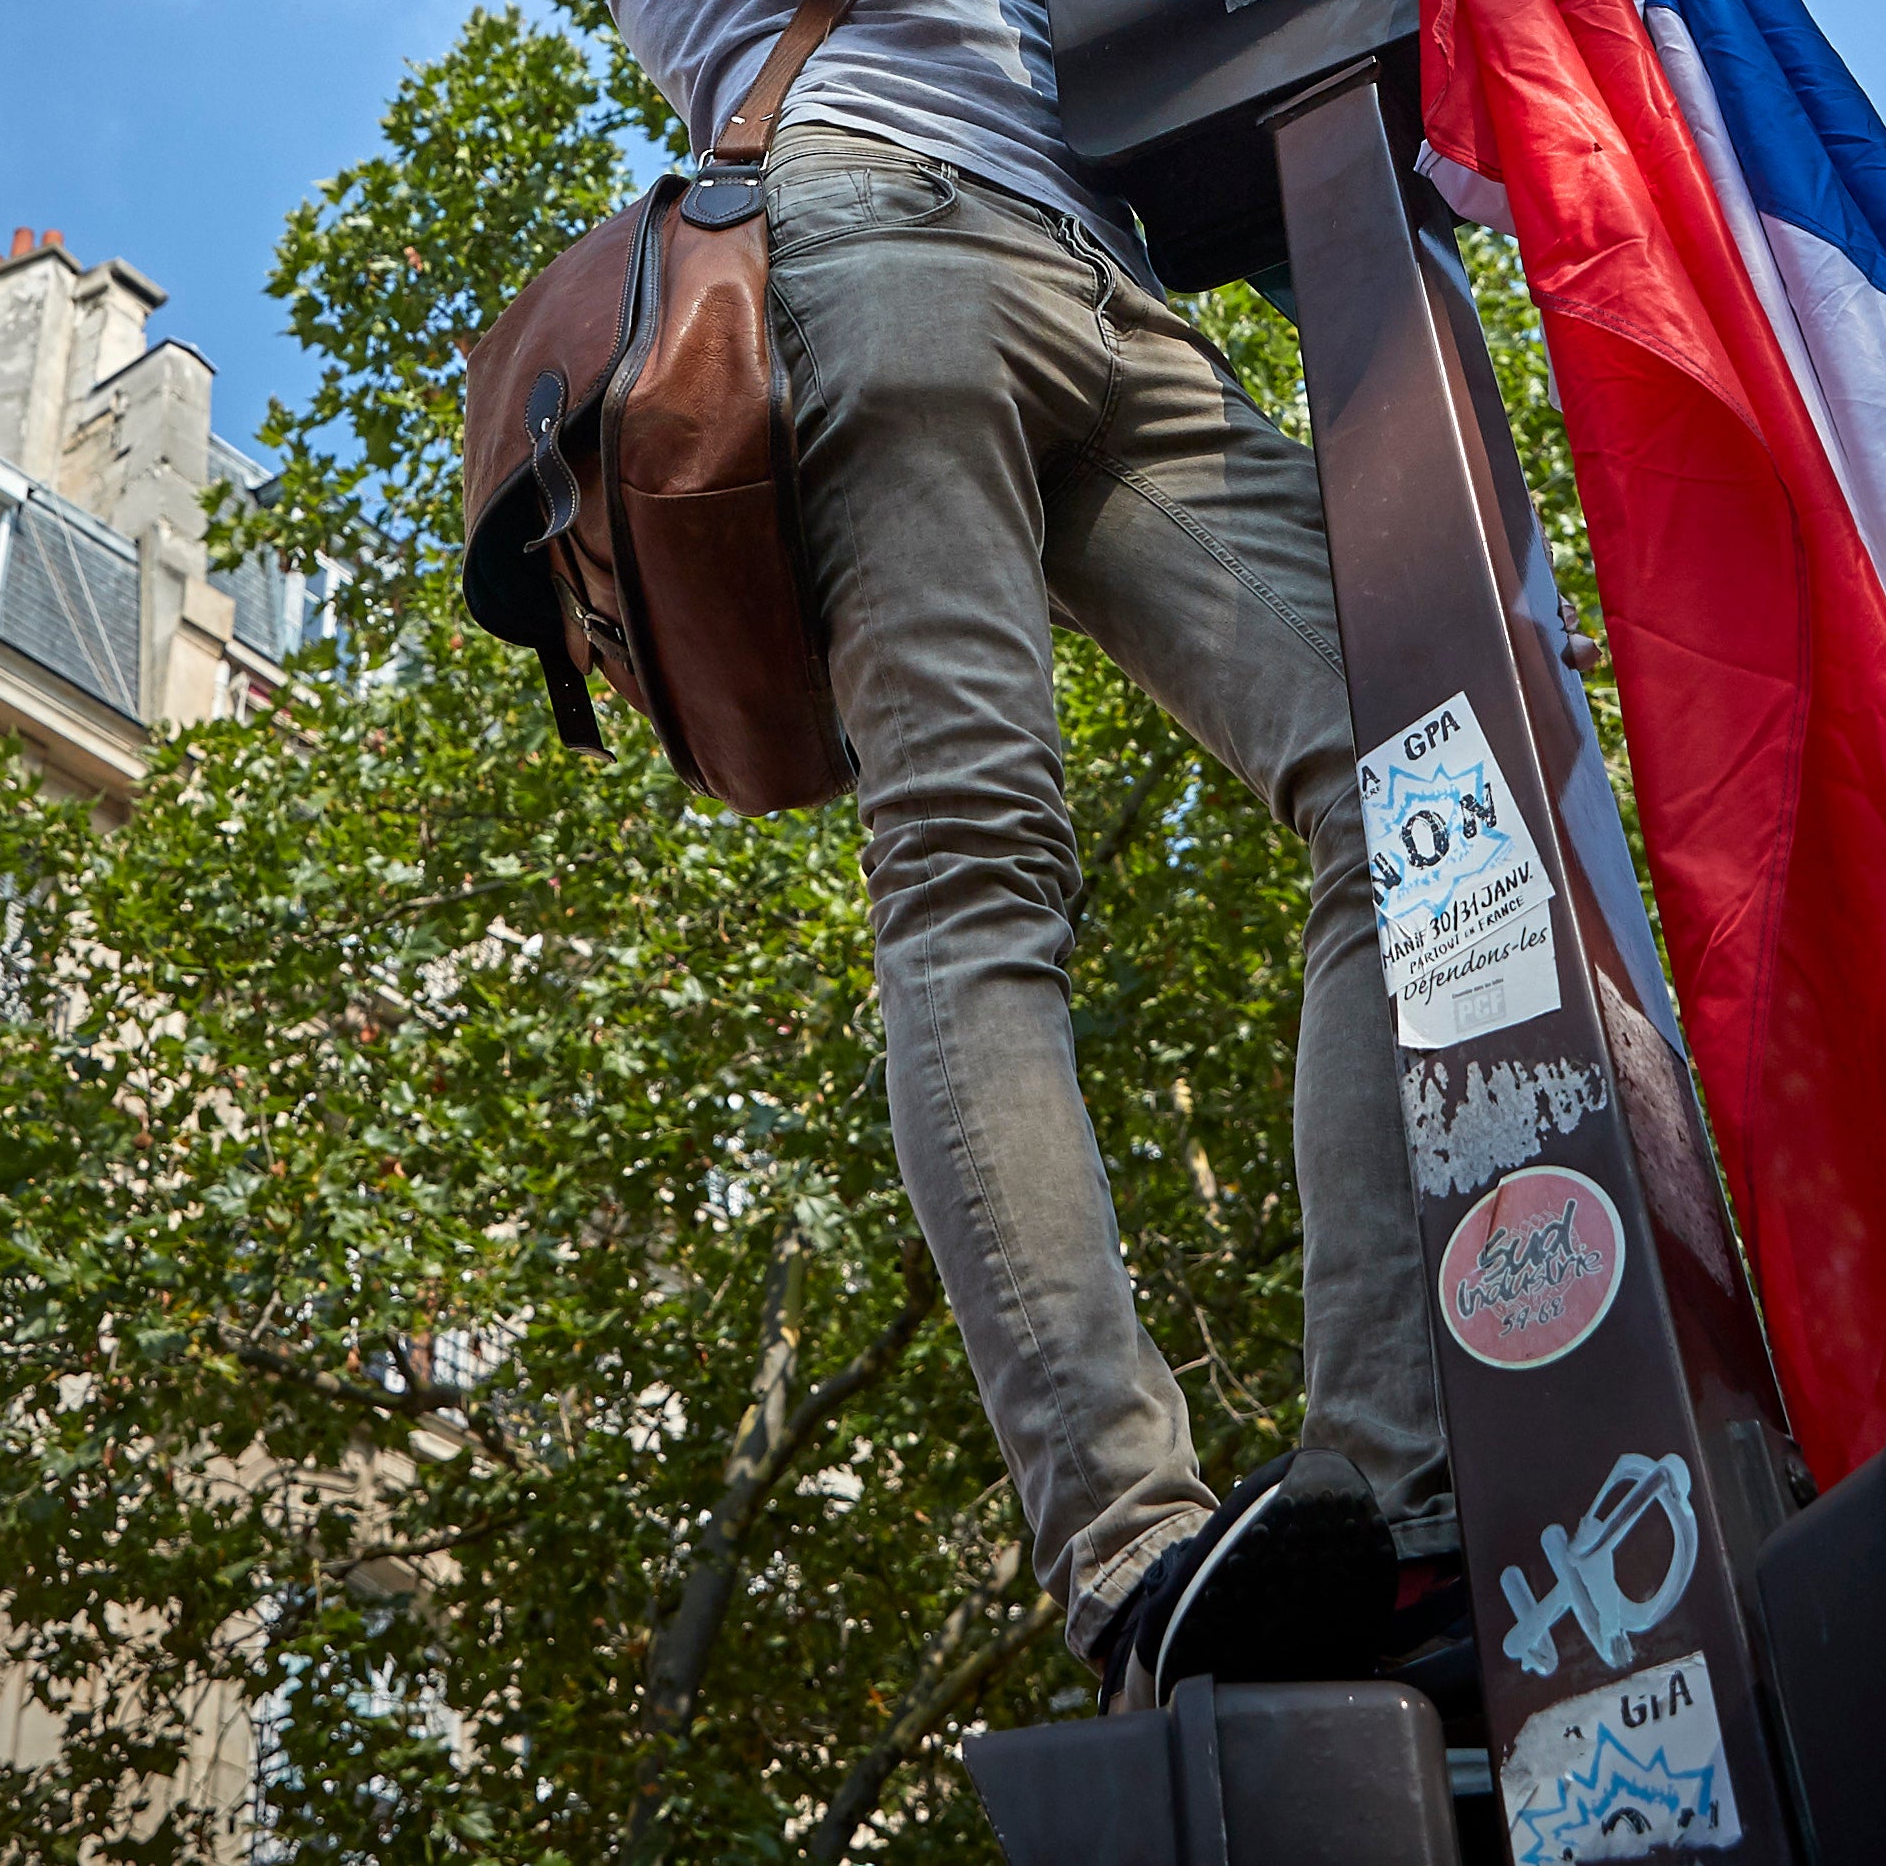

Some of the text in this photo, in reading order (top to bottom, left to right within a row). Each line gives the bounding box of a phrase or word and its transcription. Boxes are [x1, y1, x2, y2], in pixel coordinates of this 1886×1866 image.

[1404, 710, 1461, 761] GPA
[1410, 933, 1460, 974] PARTOUT
[1478, 894, 1525, 931] FRANCE
[1429, 891, 1479, 940] 30/31
[1481, 861, 1534, 908] JANV.
[1457, 987, 1504, 1025] PCF
[1477, 1198, 1577, 1283] Sud
[1457, 1243, 1602, 1320] Industrie
